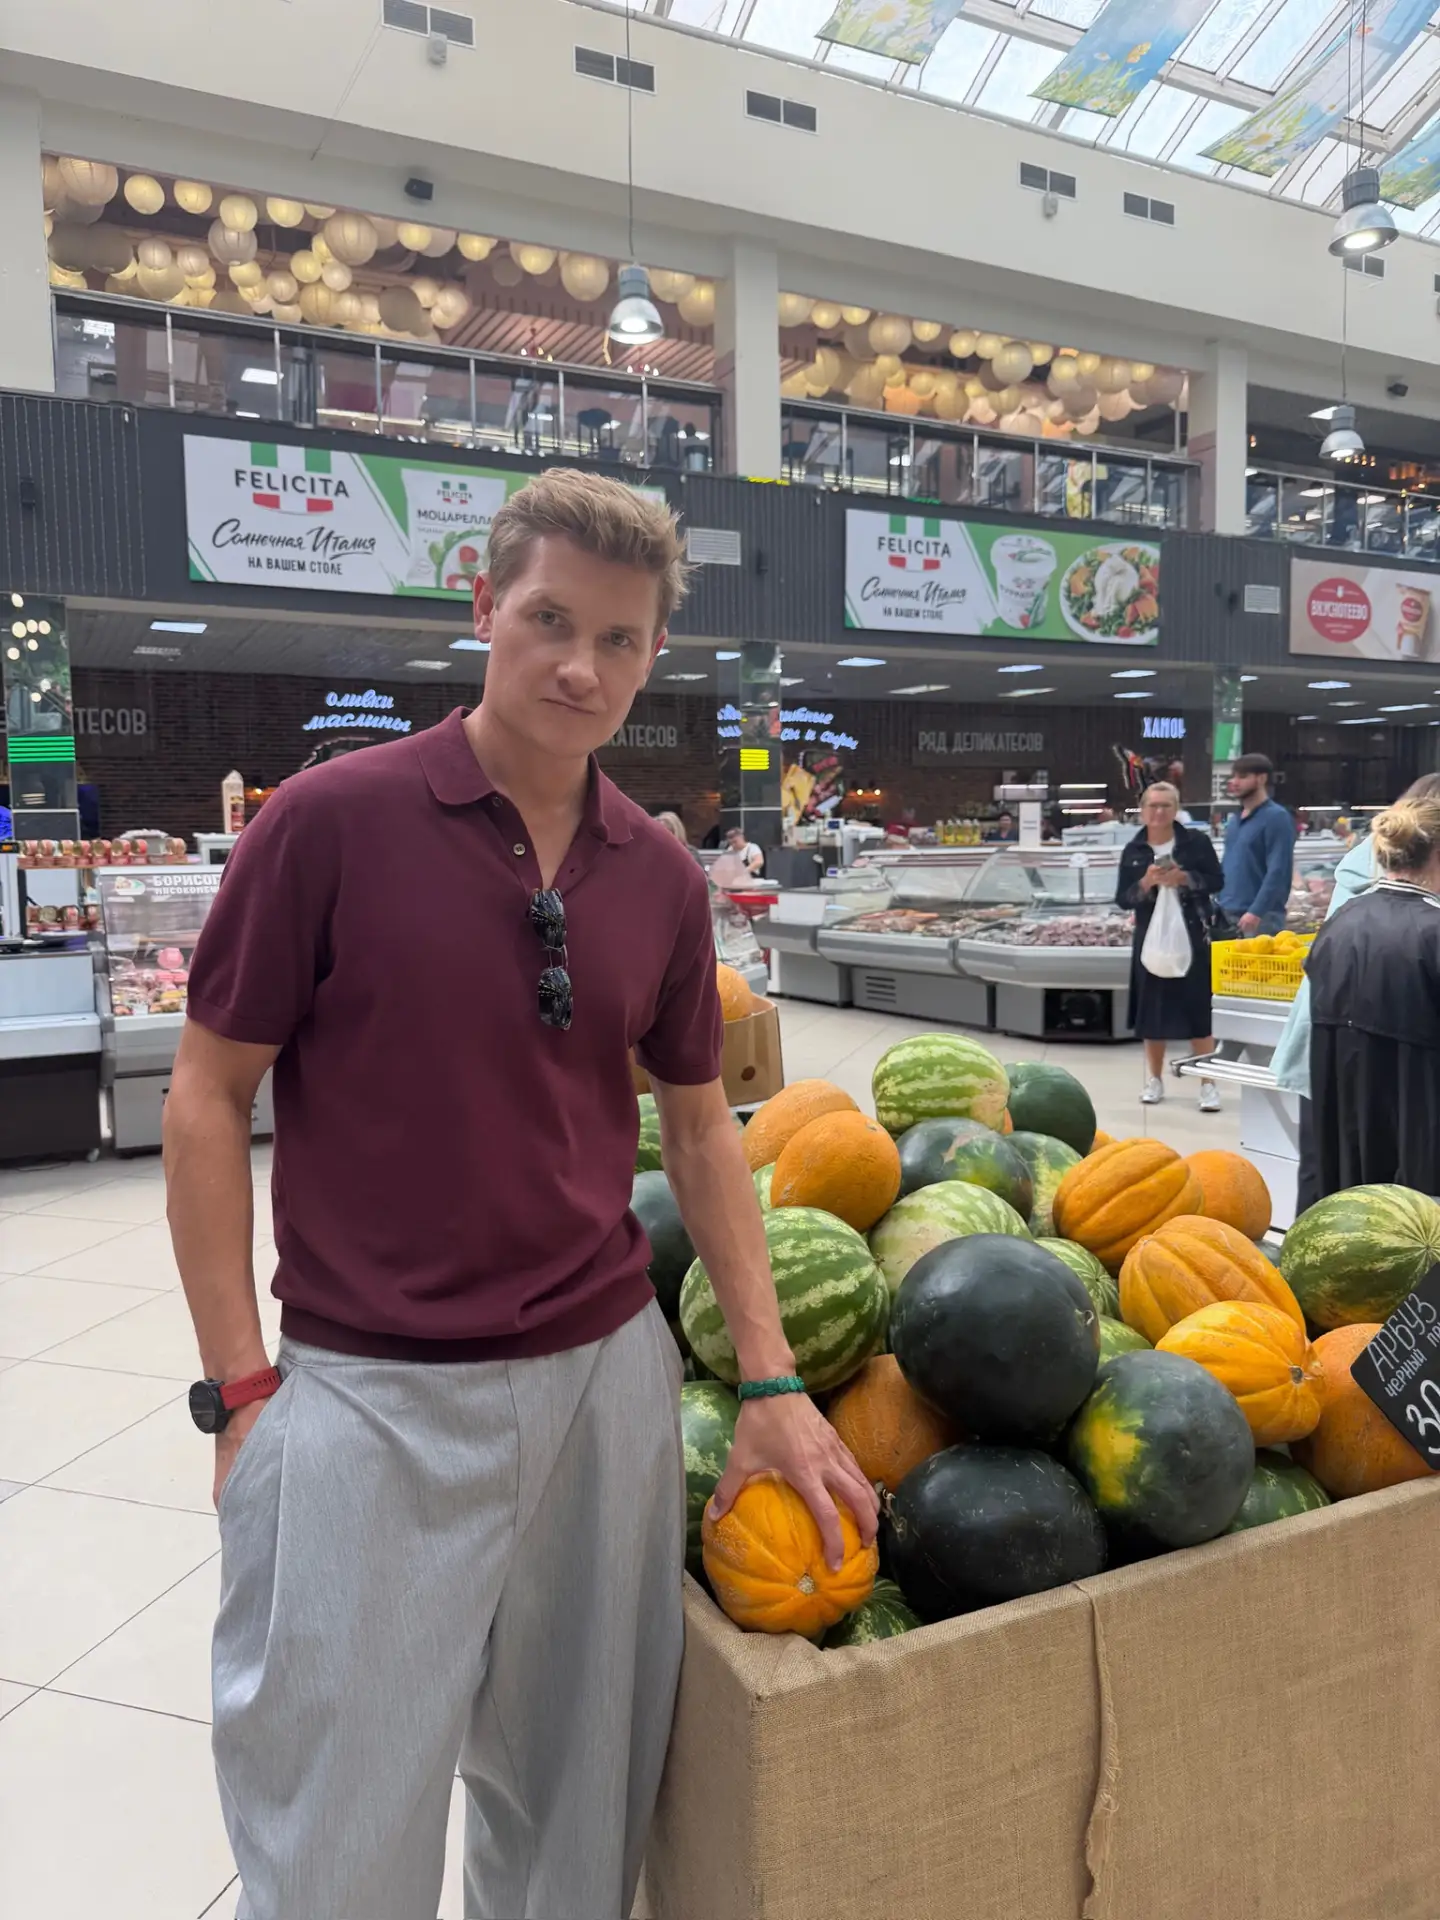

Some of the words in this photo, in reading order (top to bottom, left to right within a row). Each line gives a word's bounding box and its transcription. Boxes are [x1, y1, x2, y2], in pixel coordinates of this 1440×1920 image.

[234, 469, 349, 498] FELICITA
[212, 518, 305, 550] Солнечная
[306, 526, 376, 560] Италия
[878, 537, 951, 558] FELICITA
[248, 557, 262, 568] НА
[266, 558, 306, 572] ВАШЕМ
[311, 563, 343, 575] СТОЛЕ
[326, 689, 394, 709] оливки
[303, 713, 412, 732] маслины
[918, 731, 947, 754] РЯД
[952, 731, 1043, 755] ДЕЛИКАТЕСОВ
[1367, 1292, 1437, 1382] АРБУЗ
[1384, 1348, 1428, 1397] черный
